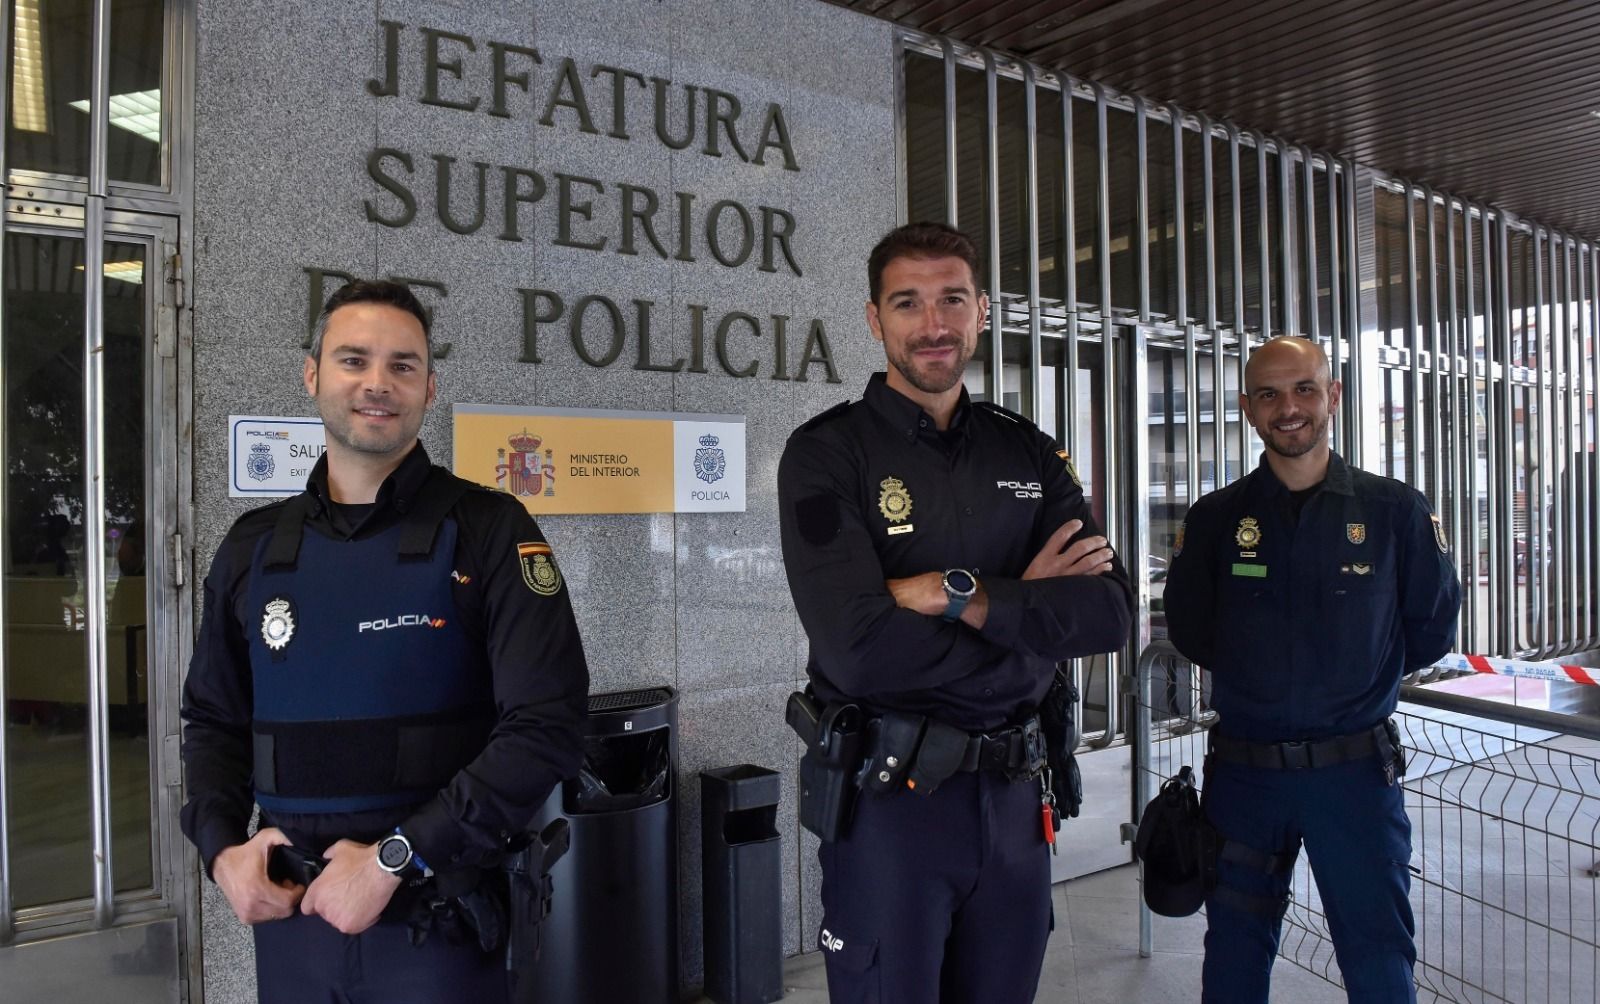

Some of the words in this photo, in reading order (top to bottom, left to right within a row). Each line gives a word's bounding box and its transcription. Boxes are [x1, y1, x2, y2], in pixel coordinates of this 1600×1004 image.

[366, 20, 801, 171] JEFATURA
[363, 147, 802, 277] SUPERIOR
[517, 288, 842, 384] POLICIA
[570, 453, 628, 465] MINISTERIO
[290, 468, 307, 477] EXIT
[570, 466, 591, 477] DEL
[592, 466, 640, 477] INTERIOR
[691, 491, 730, 501] POLICIA
[1015, 490, 1043, 499] CNP
[358, 614, 432, 632] POLICIA
[821, 929, 844, 953] CNP
